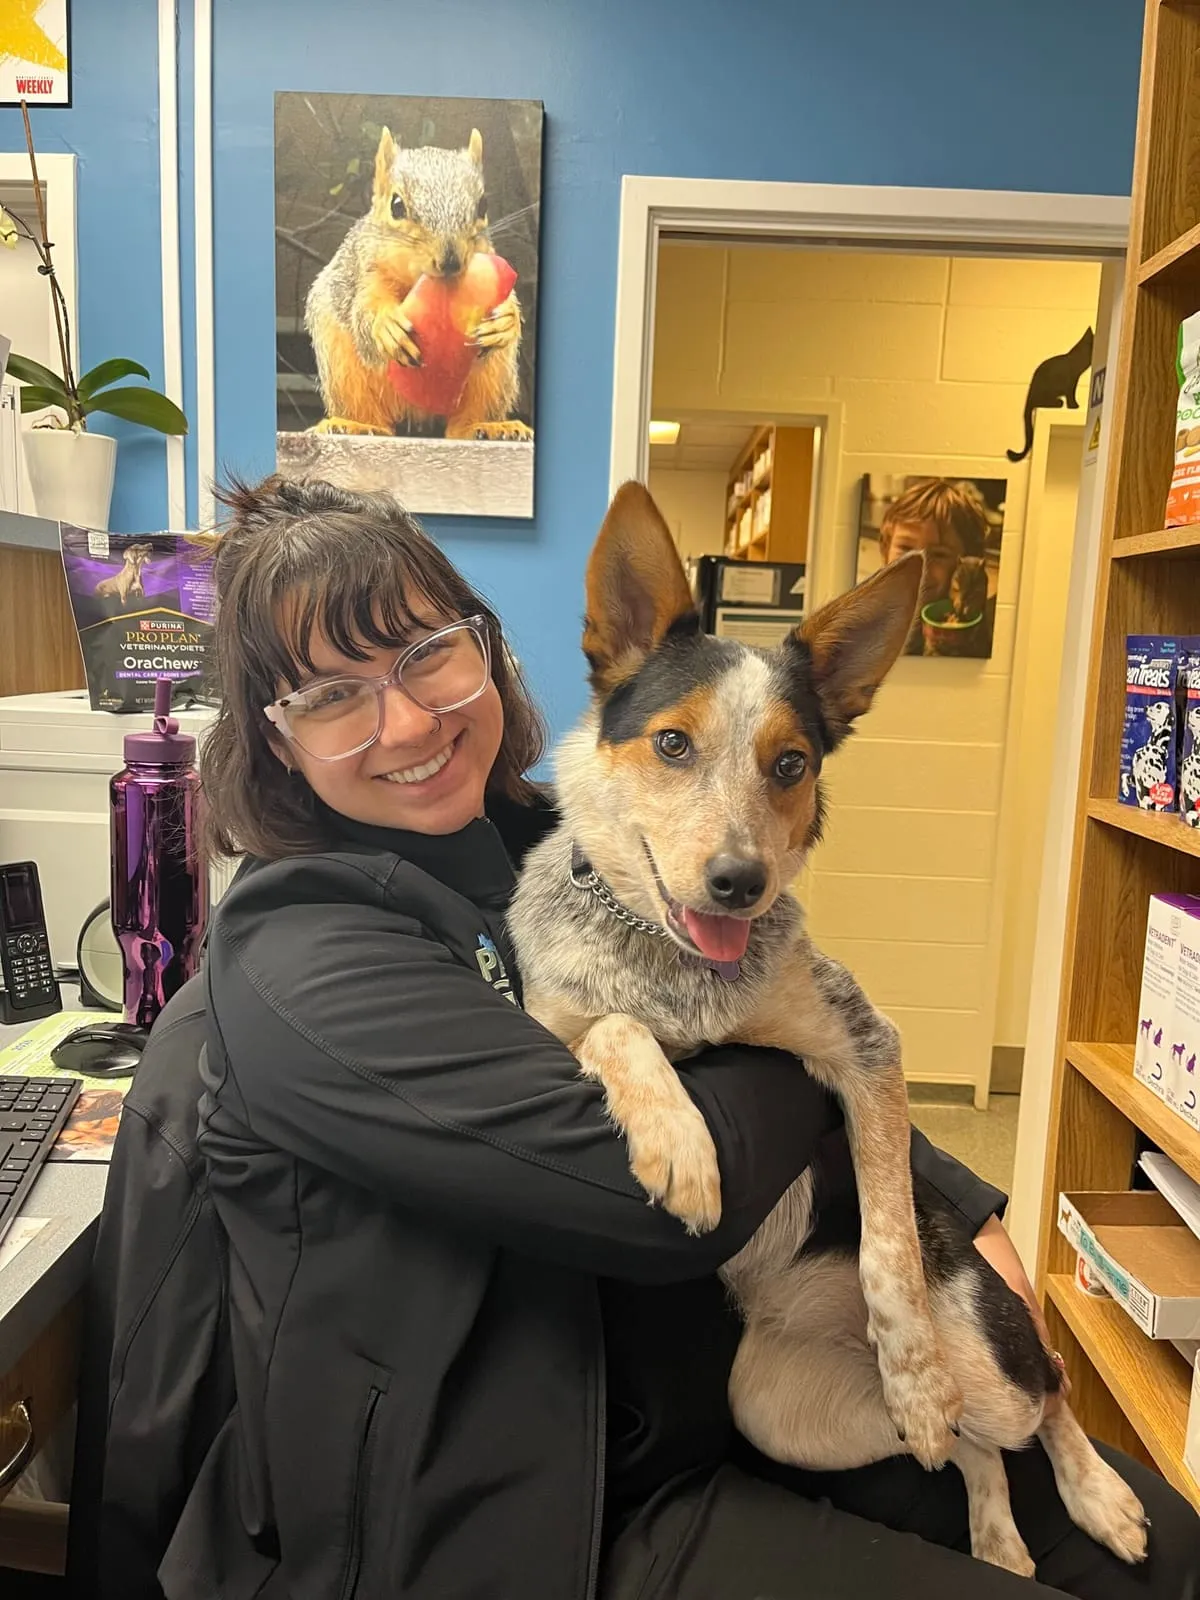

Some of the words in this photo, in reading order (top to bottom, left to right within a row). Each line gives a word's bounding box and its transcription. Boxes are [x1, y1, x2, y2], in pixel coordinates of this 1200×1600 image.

[16, 79, 54, 94] WEEKLY
[150, 622, 182, 630] PURINA
[126, 631, 158, 643] PRO
[160, 632, 200, 644] PLAN
[120, 643, 179, 653] VETERINARY
[180, 644, 205, 652] DIETS
[124, 656, 199, 670] OraChews
